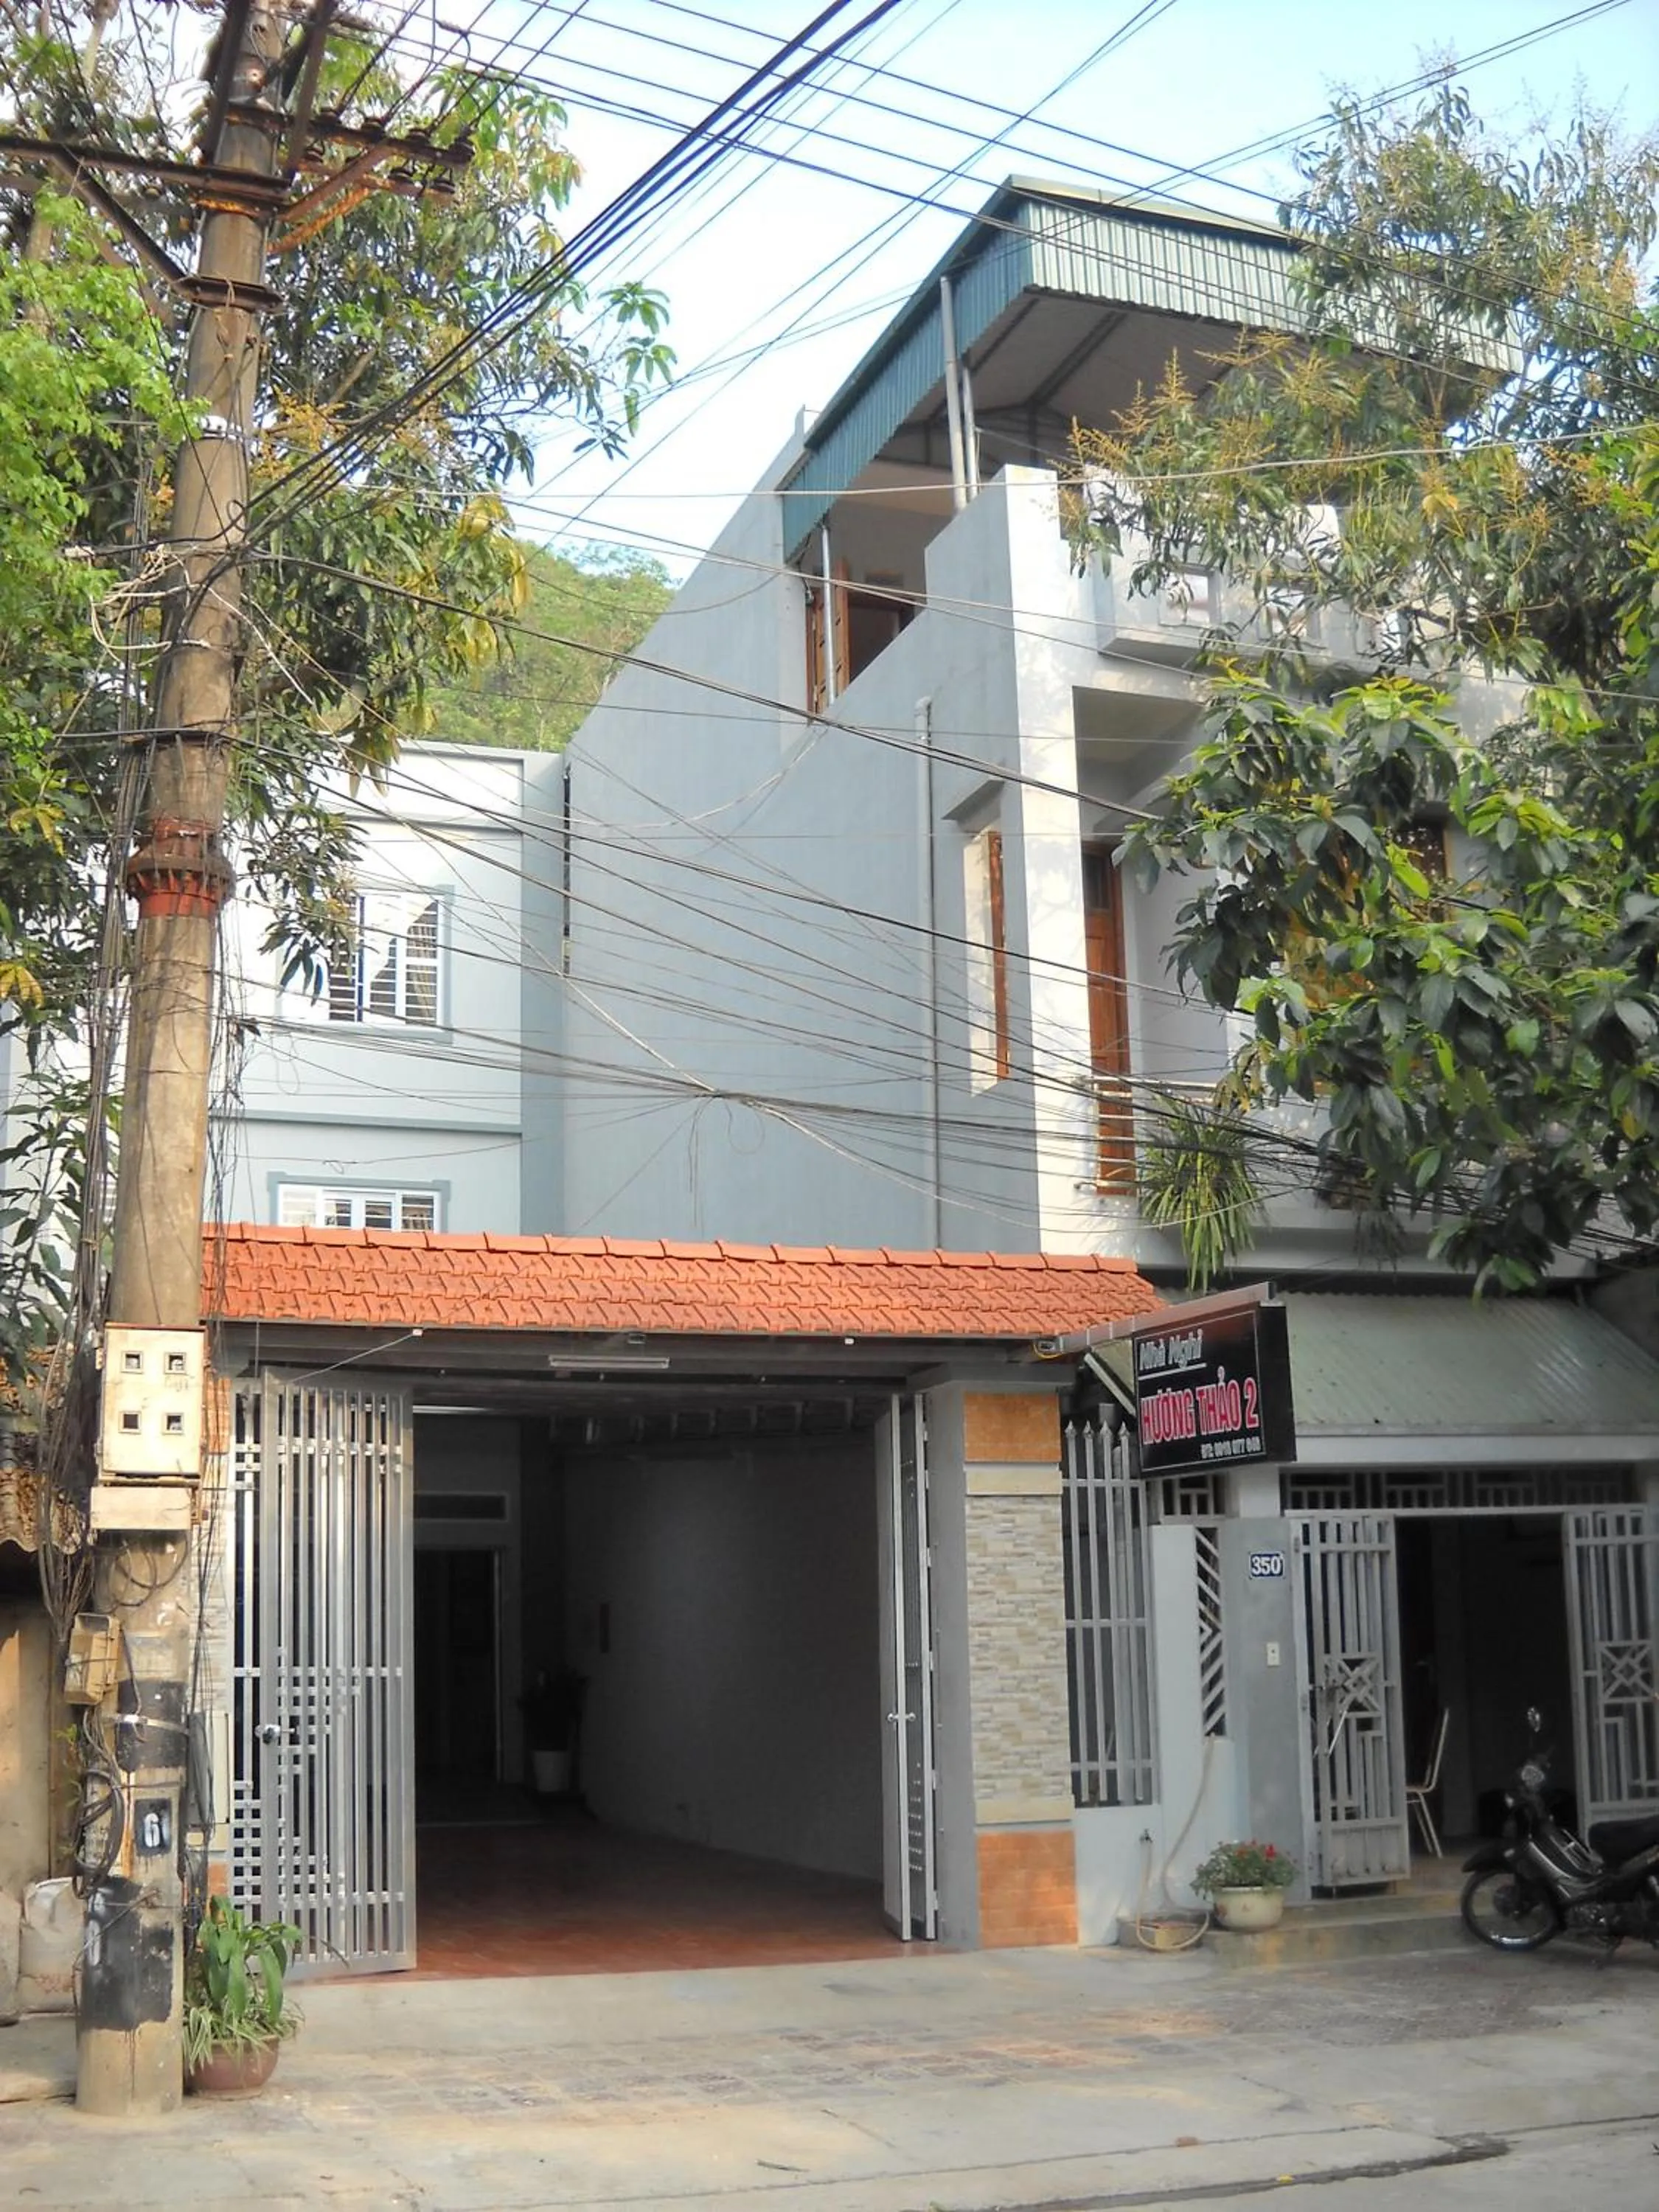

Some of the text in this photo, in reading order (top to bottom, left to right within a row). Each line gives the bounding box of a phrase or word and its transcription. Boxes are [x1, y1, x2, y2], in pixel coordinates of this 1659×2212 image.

[1140, 1329, 1203, 1370] Nhà Nghỉ
[1141, 1366, 1259, 1444] HƯƠNG THẢO 2
[1252, 1556, 1281, 1575] 350
